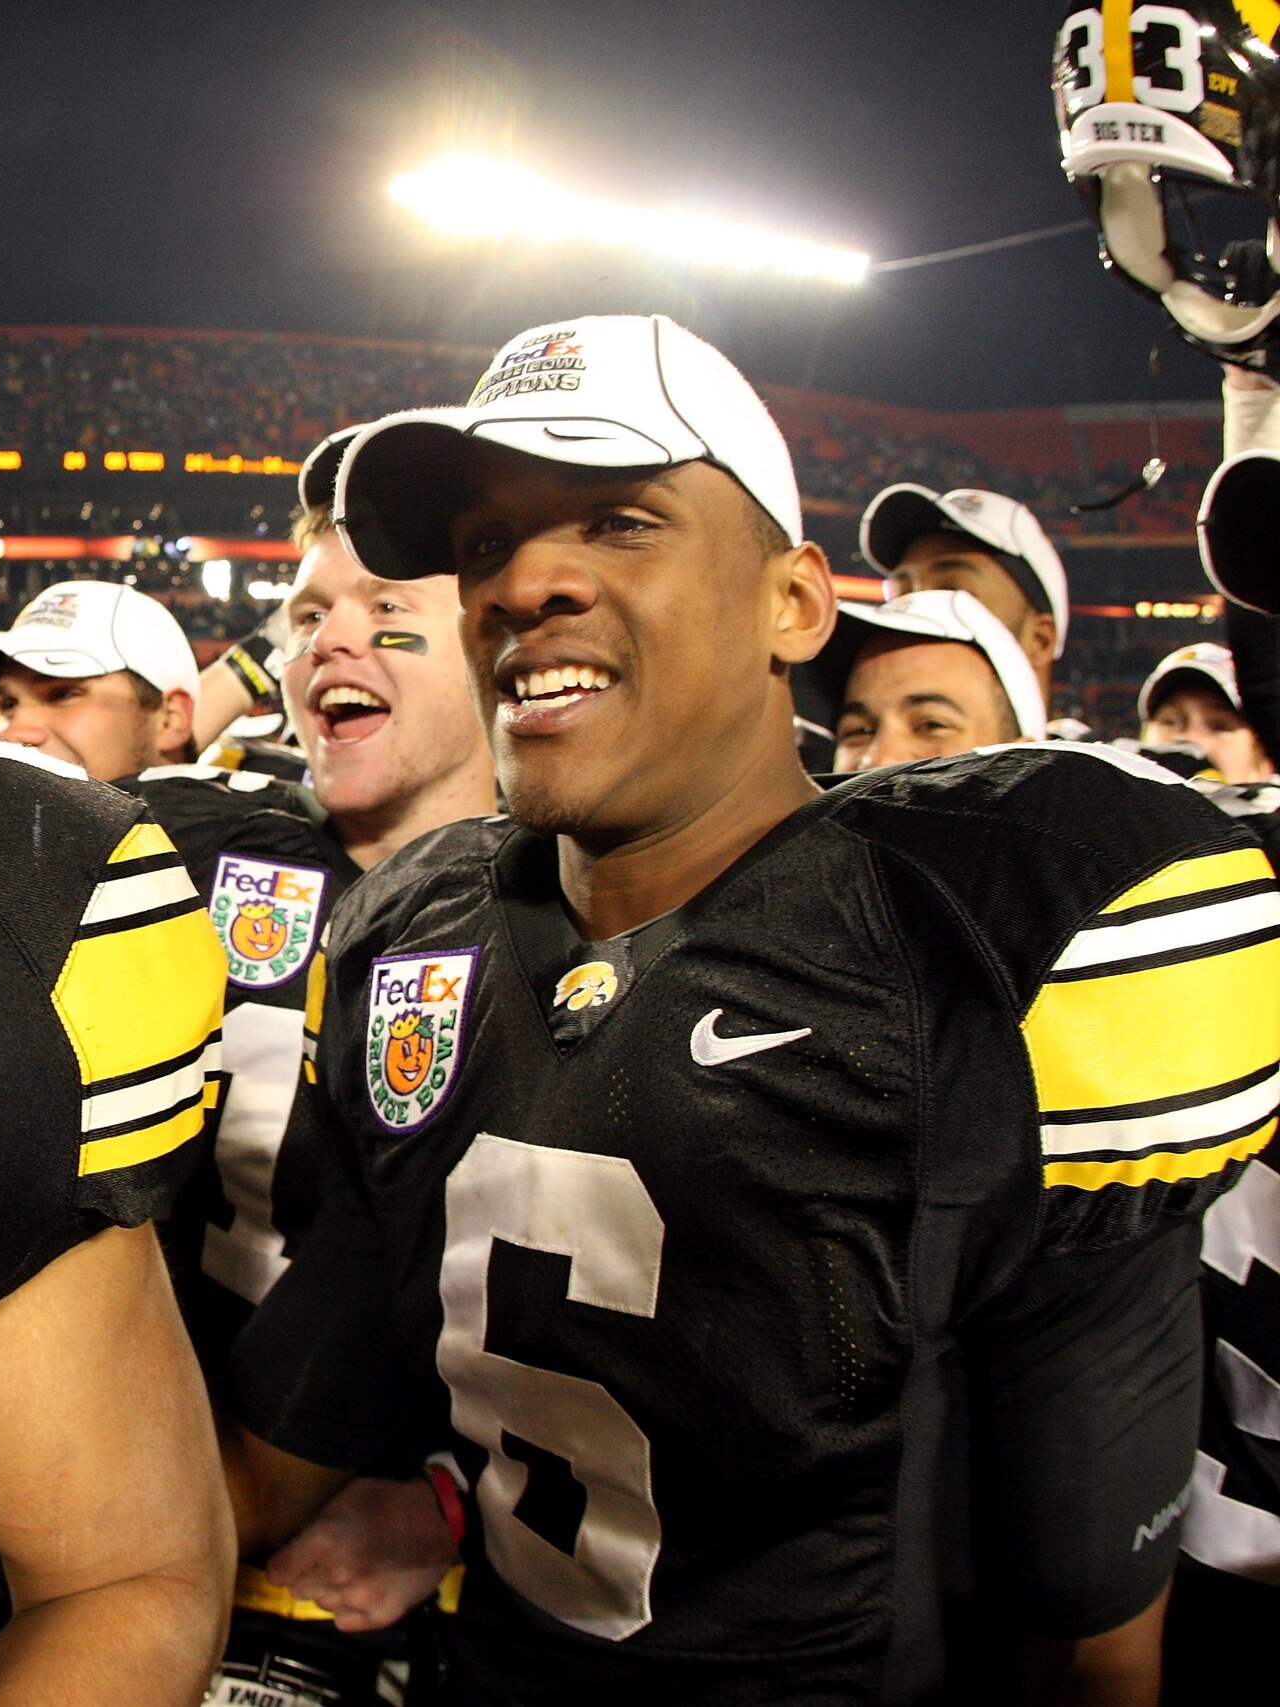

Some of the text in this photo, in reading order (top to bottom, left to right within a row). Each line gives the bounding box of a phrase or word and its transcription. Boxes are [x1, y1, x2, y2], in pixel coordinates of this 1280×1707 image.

[1093, 121, 1165, 143] BIG TEN
[500, 340, 584, 369] FedEx
[526, 357, 587, 373] BOWL
[220, 861, 315, 904] FedEx
[269, 908, 312, 977] BOWL
[374, 964, 462, 1006] FedEx
[369, 1008, 458, 1124] ORANGE BOWL
[436, 1132, 665, 1642] 6
